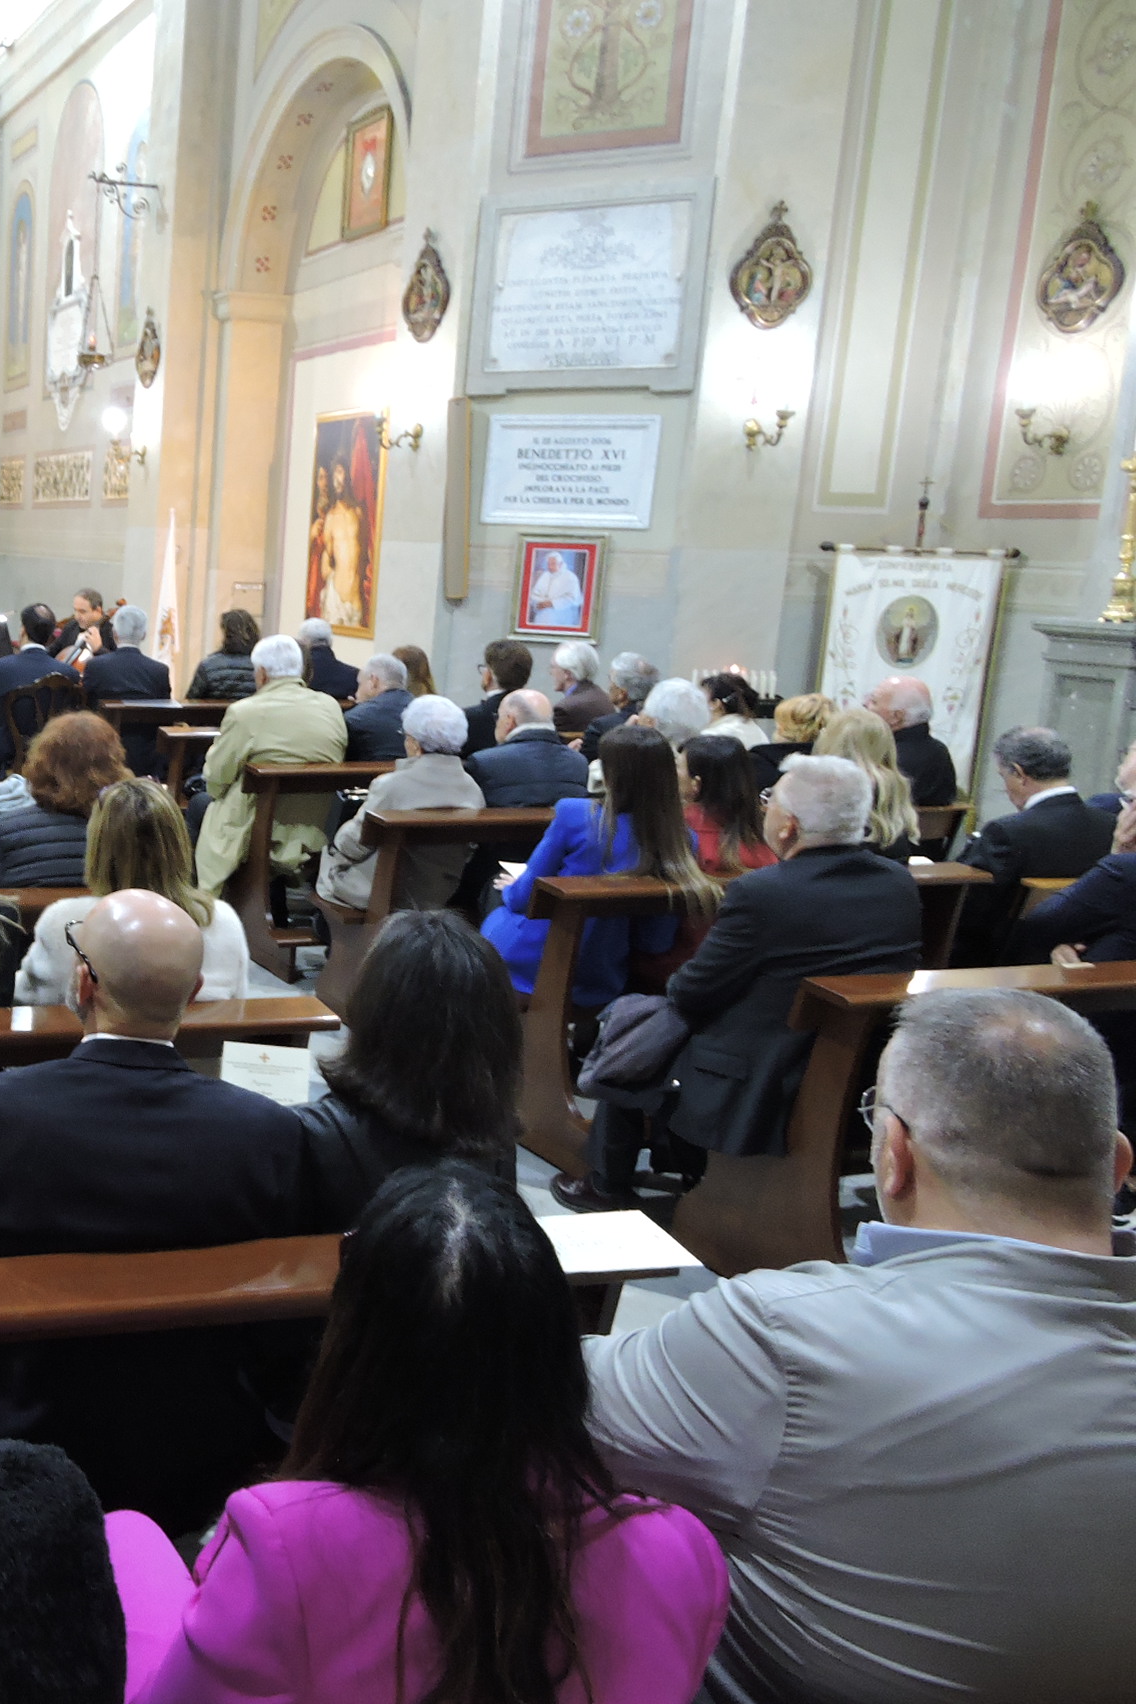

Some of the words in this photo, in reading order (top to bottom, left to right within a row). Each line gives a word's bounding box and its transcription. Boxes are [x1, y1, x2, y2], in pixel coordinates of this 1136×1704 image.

[553, 437, 590, 445] AGOSTO
[517, 447, 593, 460] BENEDETTO
[601, 449, 627, 460] XVI
[518, 463, 588, 471] INGINOCCHIATO
[600, 464, 622, 472] PIEDI
[535, 474, 549, 482] DEL
[551, 474, 602, 483] CROCIFISSO
[524, 485, 573, 493] IMPLORAVA
[588, 486, 610, 494] PACE
[503, 495, 518, 503] PER
[532, 496, 562, 504] CHIESA
[570, 497, 585, 505] PER
[596, 498, 630, 506] MONDO
[911, 578, 938, 589] DELLA
